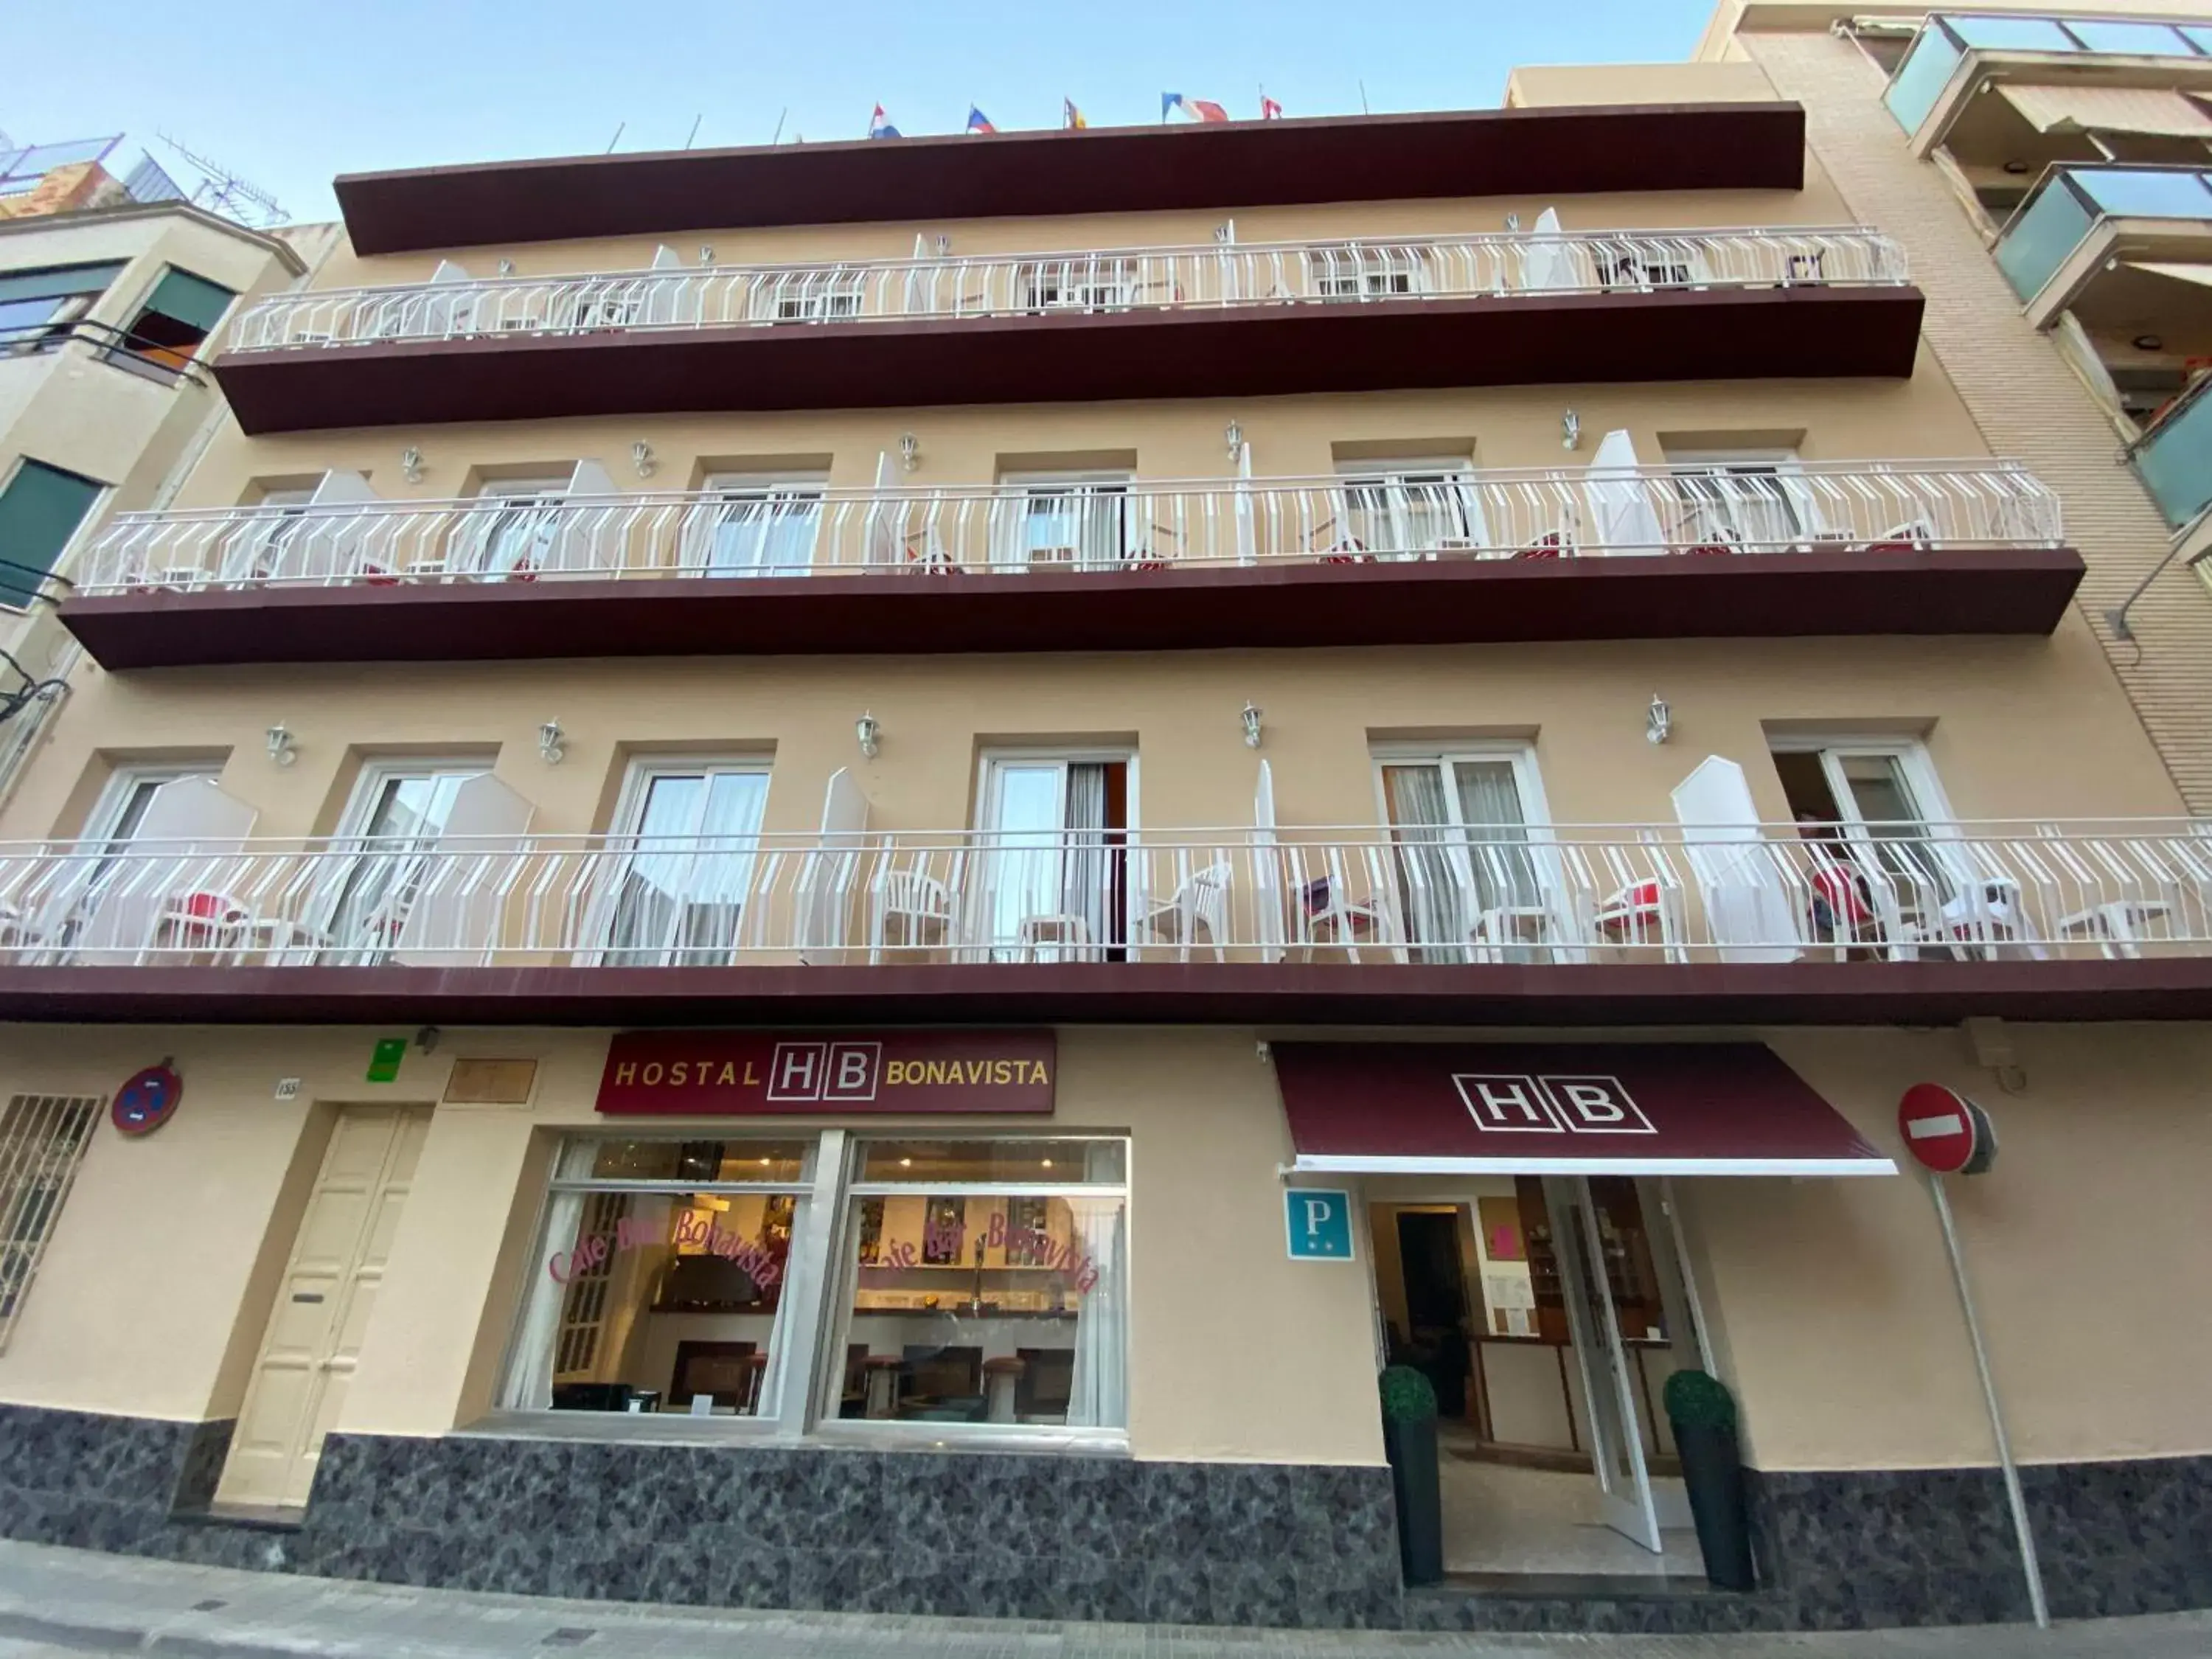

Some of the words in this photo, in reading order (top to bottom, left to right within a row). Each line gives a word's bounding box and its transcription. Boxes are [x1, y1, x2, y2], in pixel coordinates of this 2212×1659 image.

[615, 1062, 760, 1086] HOSTAL
[886, 1061, 1048, 1085] BONAVISTA
[1304, 1200, 1331, 1235] P
